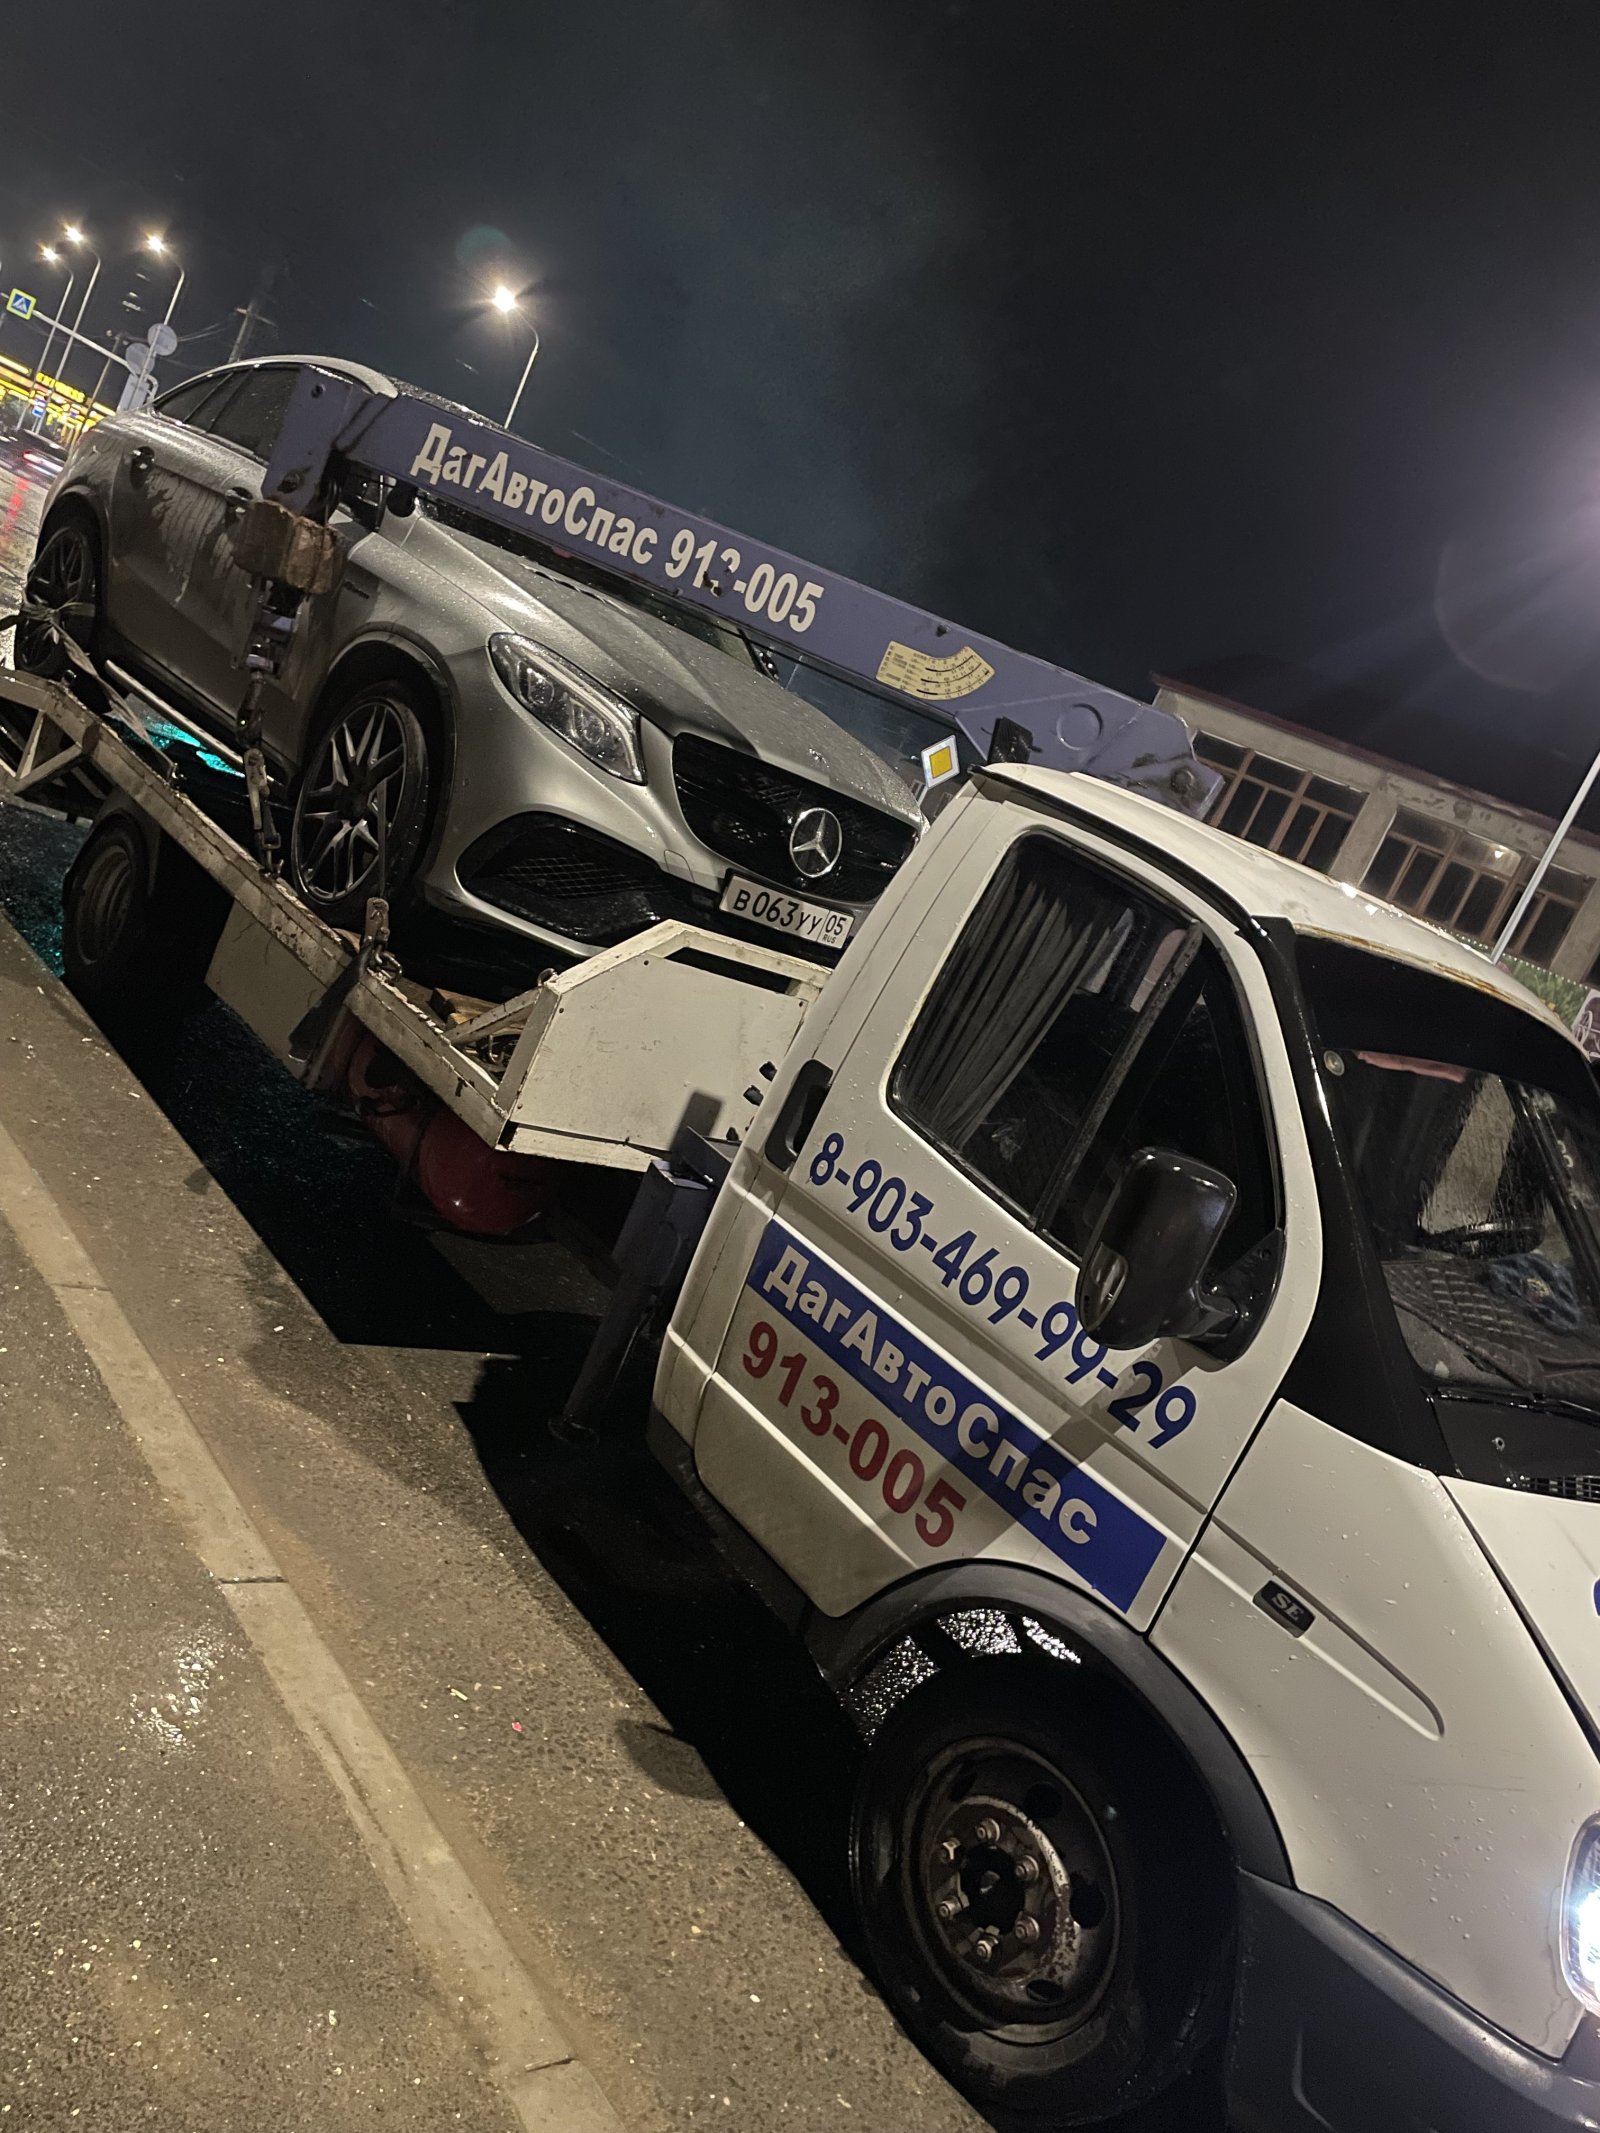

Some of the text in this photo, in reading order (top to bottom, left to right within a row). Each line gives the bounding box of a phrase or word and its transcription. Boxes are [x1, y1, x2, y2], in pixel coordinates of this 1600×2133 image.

[411, 423, 658, 565] ДагАвтоСпас
[821, 933, 837, 945] RUS
[825, 914, 847, 936] 05
[810, 1132, 1197, 1449] 8-903-469-99-29
[742, 1321, 967, 1547] 913-005
[763, 1245, 1098, 1545] ДагАвтоСпас
[1271, 1592, 1304, 1621] SE
